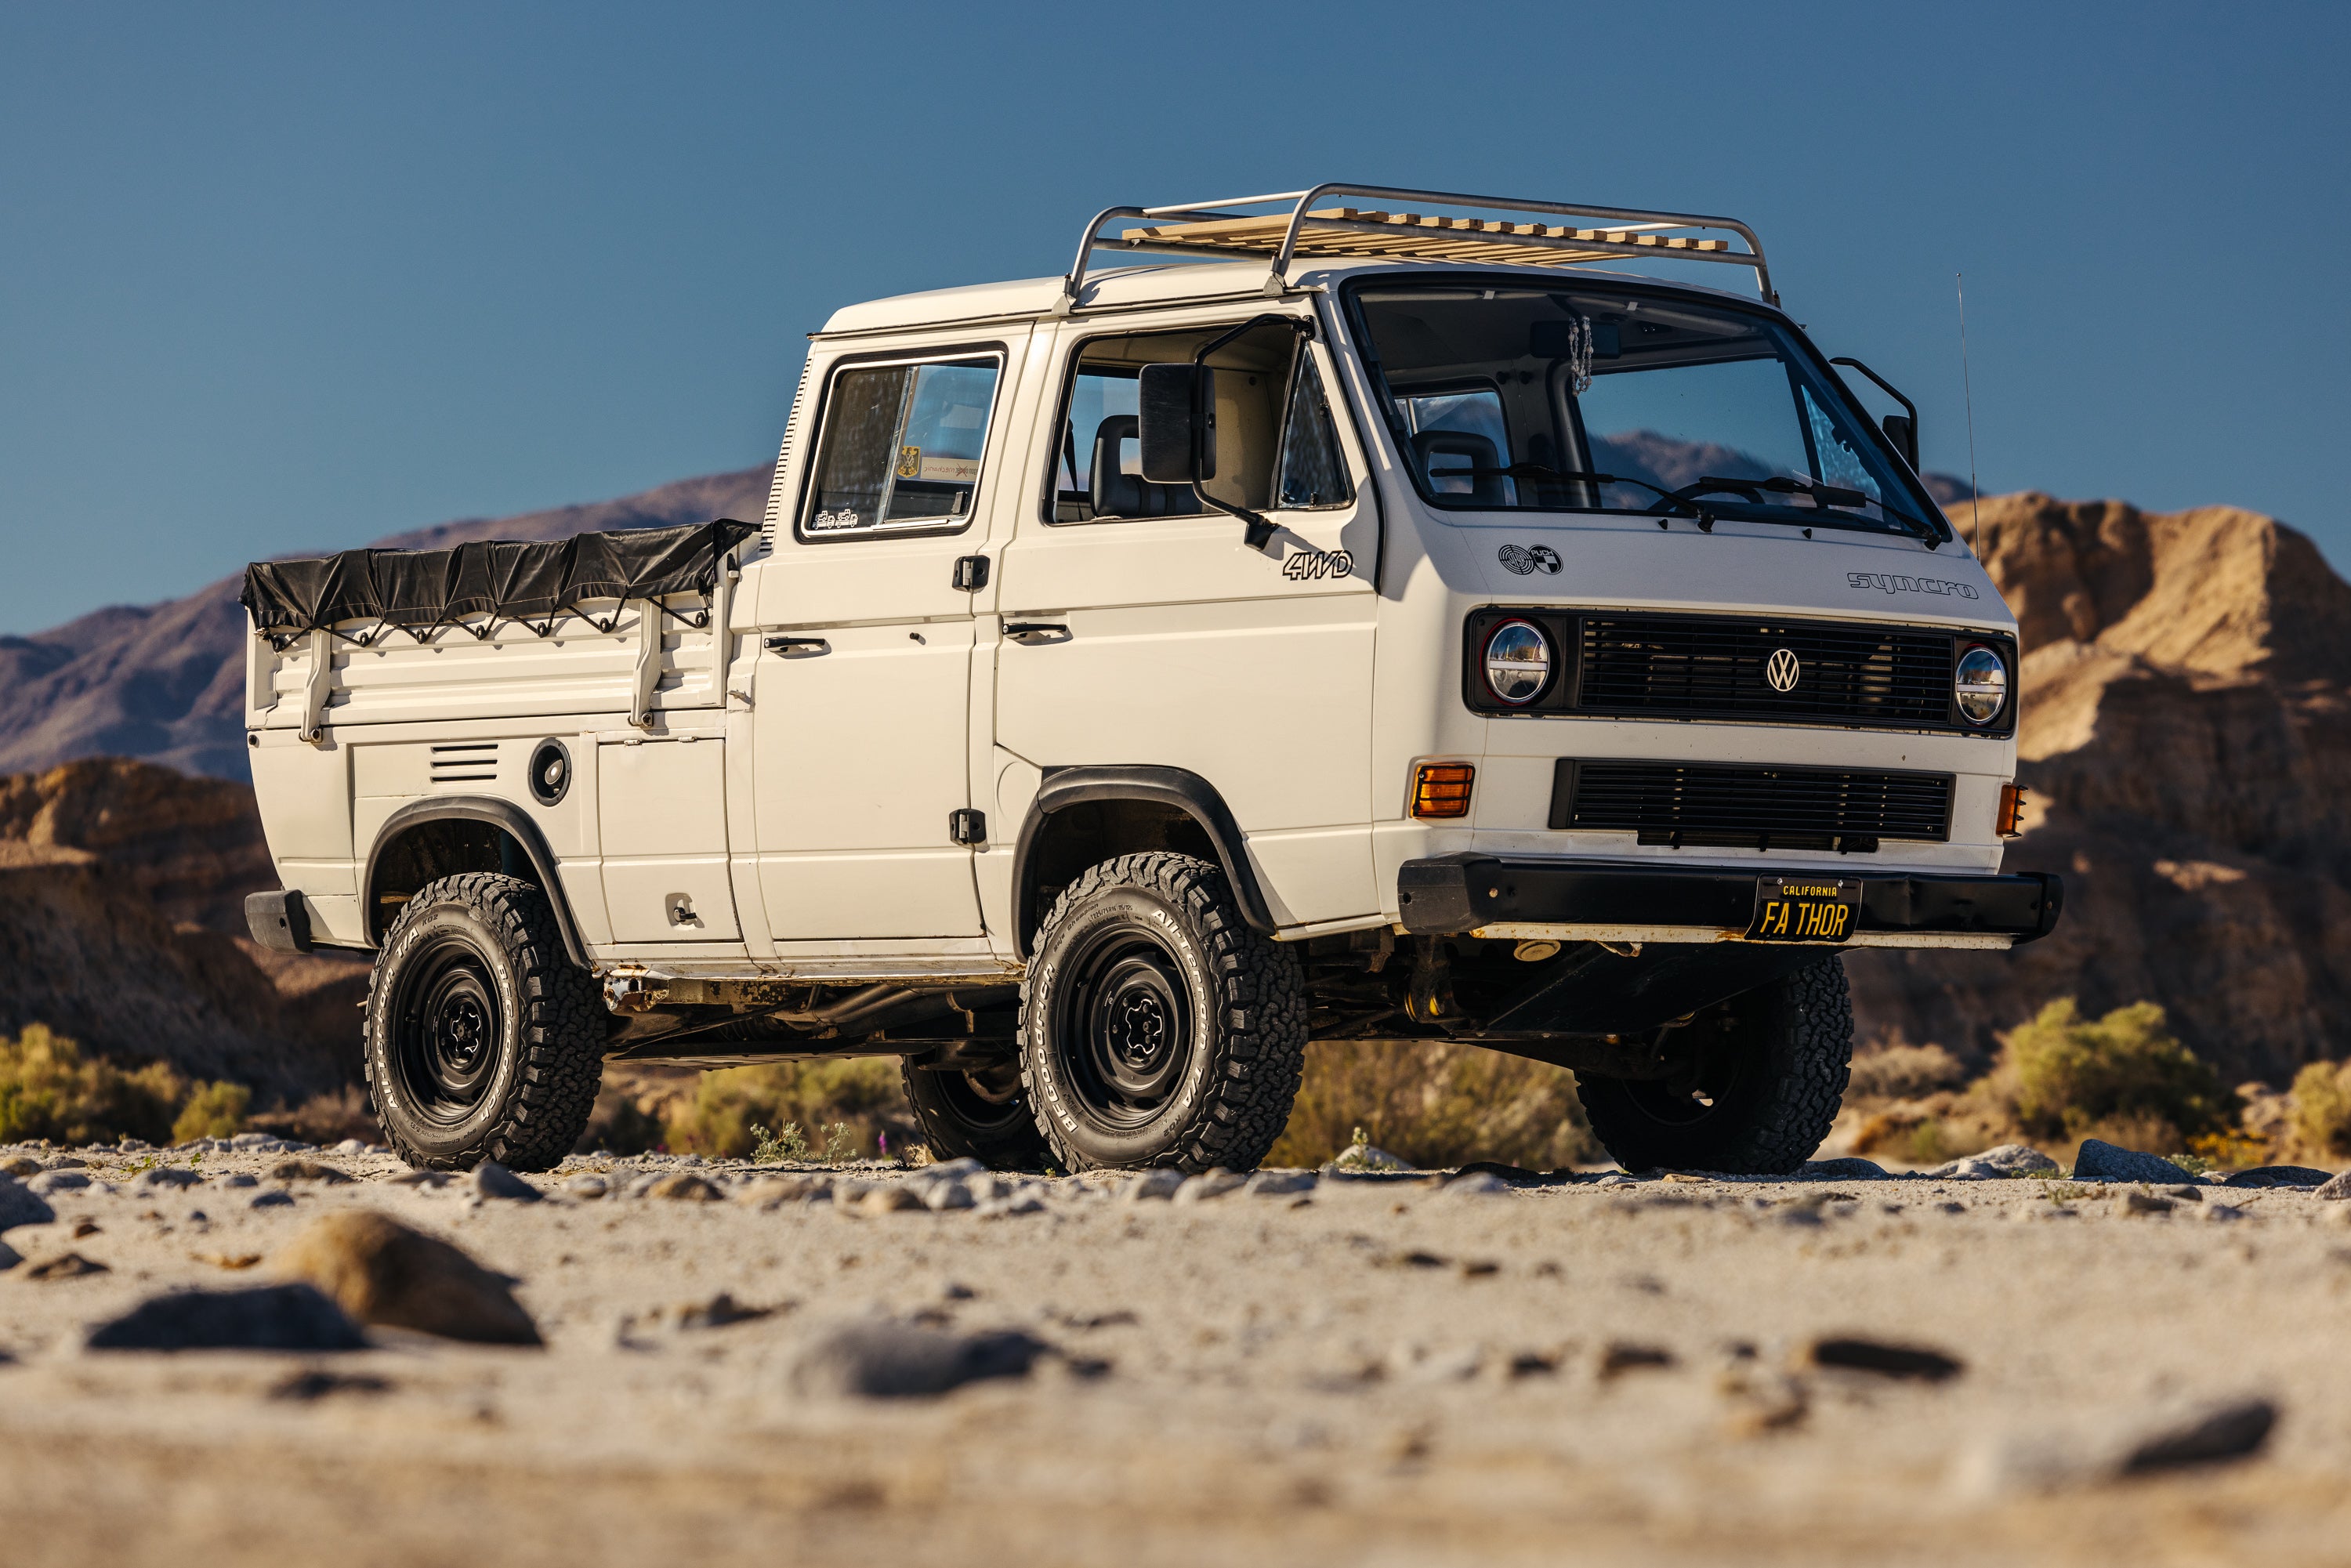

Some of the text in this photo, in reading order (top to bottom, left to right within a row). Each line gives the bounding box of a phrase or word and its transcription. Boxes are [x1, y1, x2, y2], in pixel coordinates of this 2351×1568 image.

[1283, 549, 1353, 581] 4WD
[1847, 572, 1980, 599] syncro
[1767, 649, 1799, 692] VW
[1783, 885, 1837, 896] CALIFORNIA
[422, 914, 439, 926] KO2
[1759, 902, 1849, 936] FA THOR
[375, 926, 420, 1110] All-Terrain T/A
[1150, 908, 1212, 1109] All-Terrain T/A
[480, 964, 514, 1122] BFGoodrich
[1034, 962, 1078, 1133] BFGoodrich
[1163, 1114, 1181, 1136] KO2
